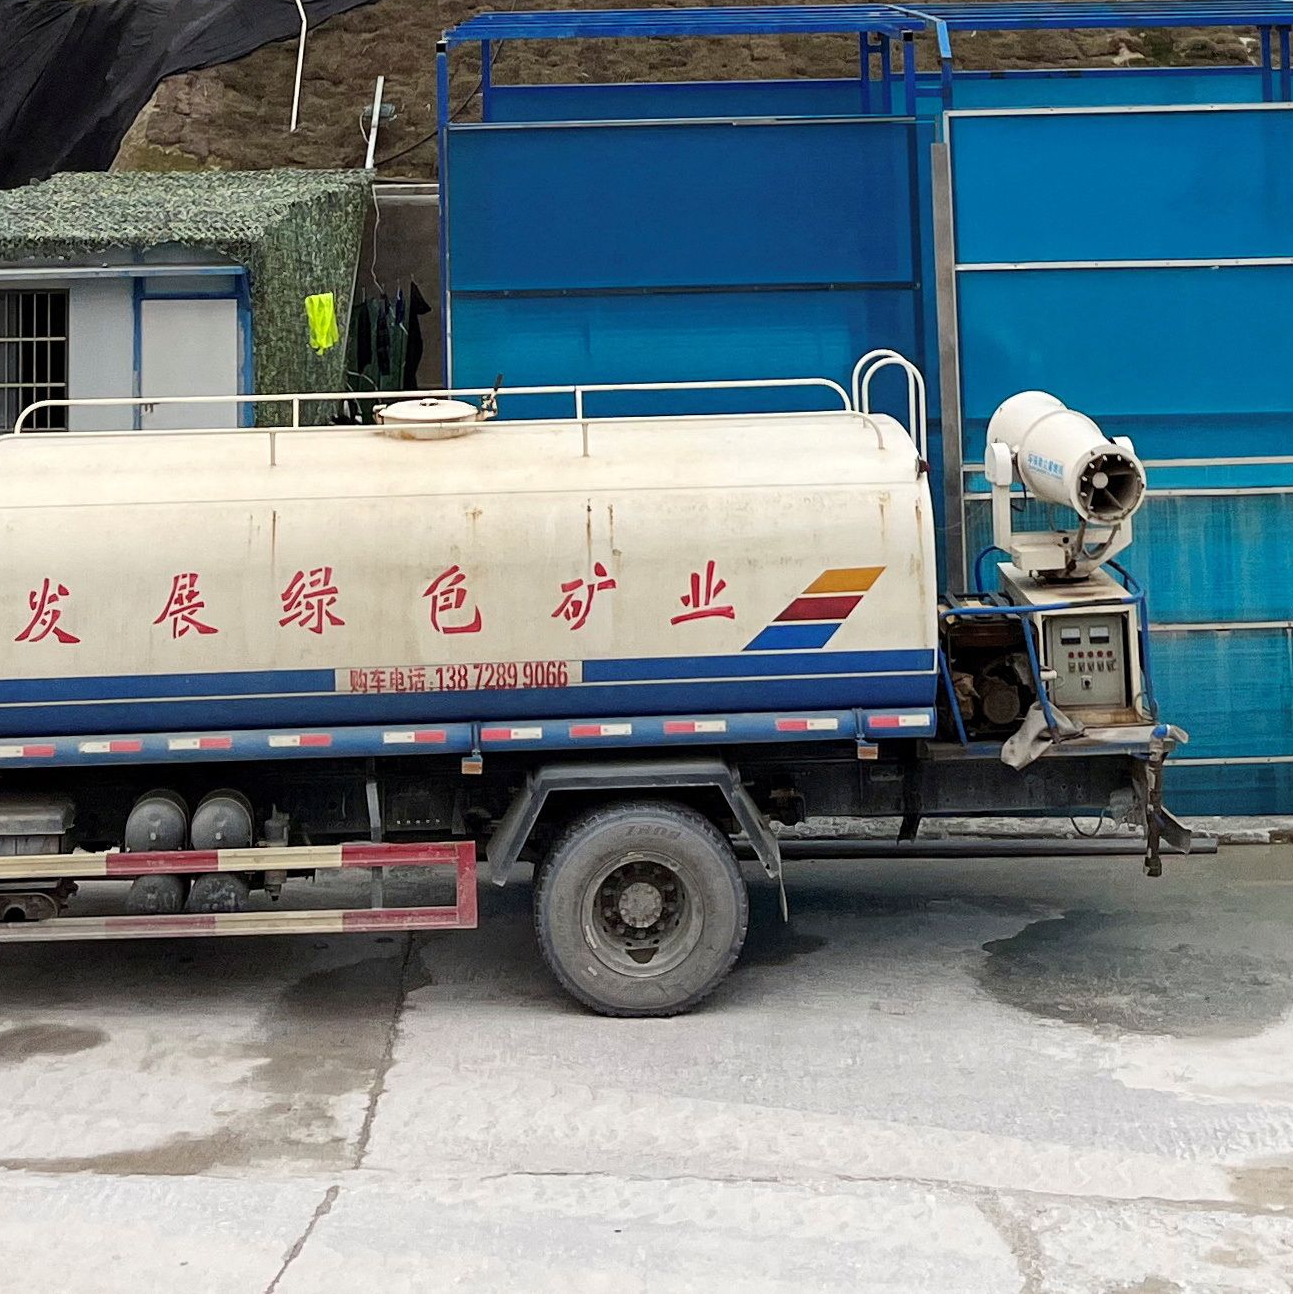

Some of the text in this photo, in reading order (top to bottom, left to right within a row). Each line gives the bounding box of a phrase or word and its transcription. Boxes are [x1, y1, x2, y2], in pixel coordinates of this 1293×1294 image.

[12, 559, 737, 645] 发展绿色矿业
